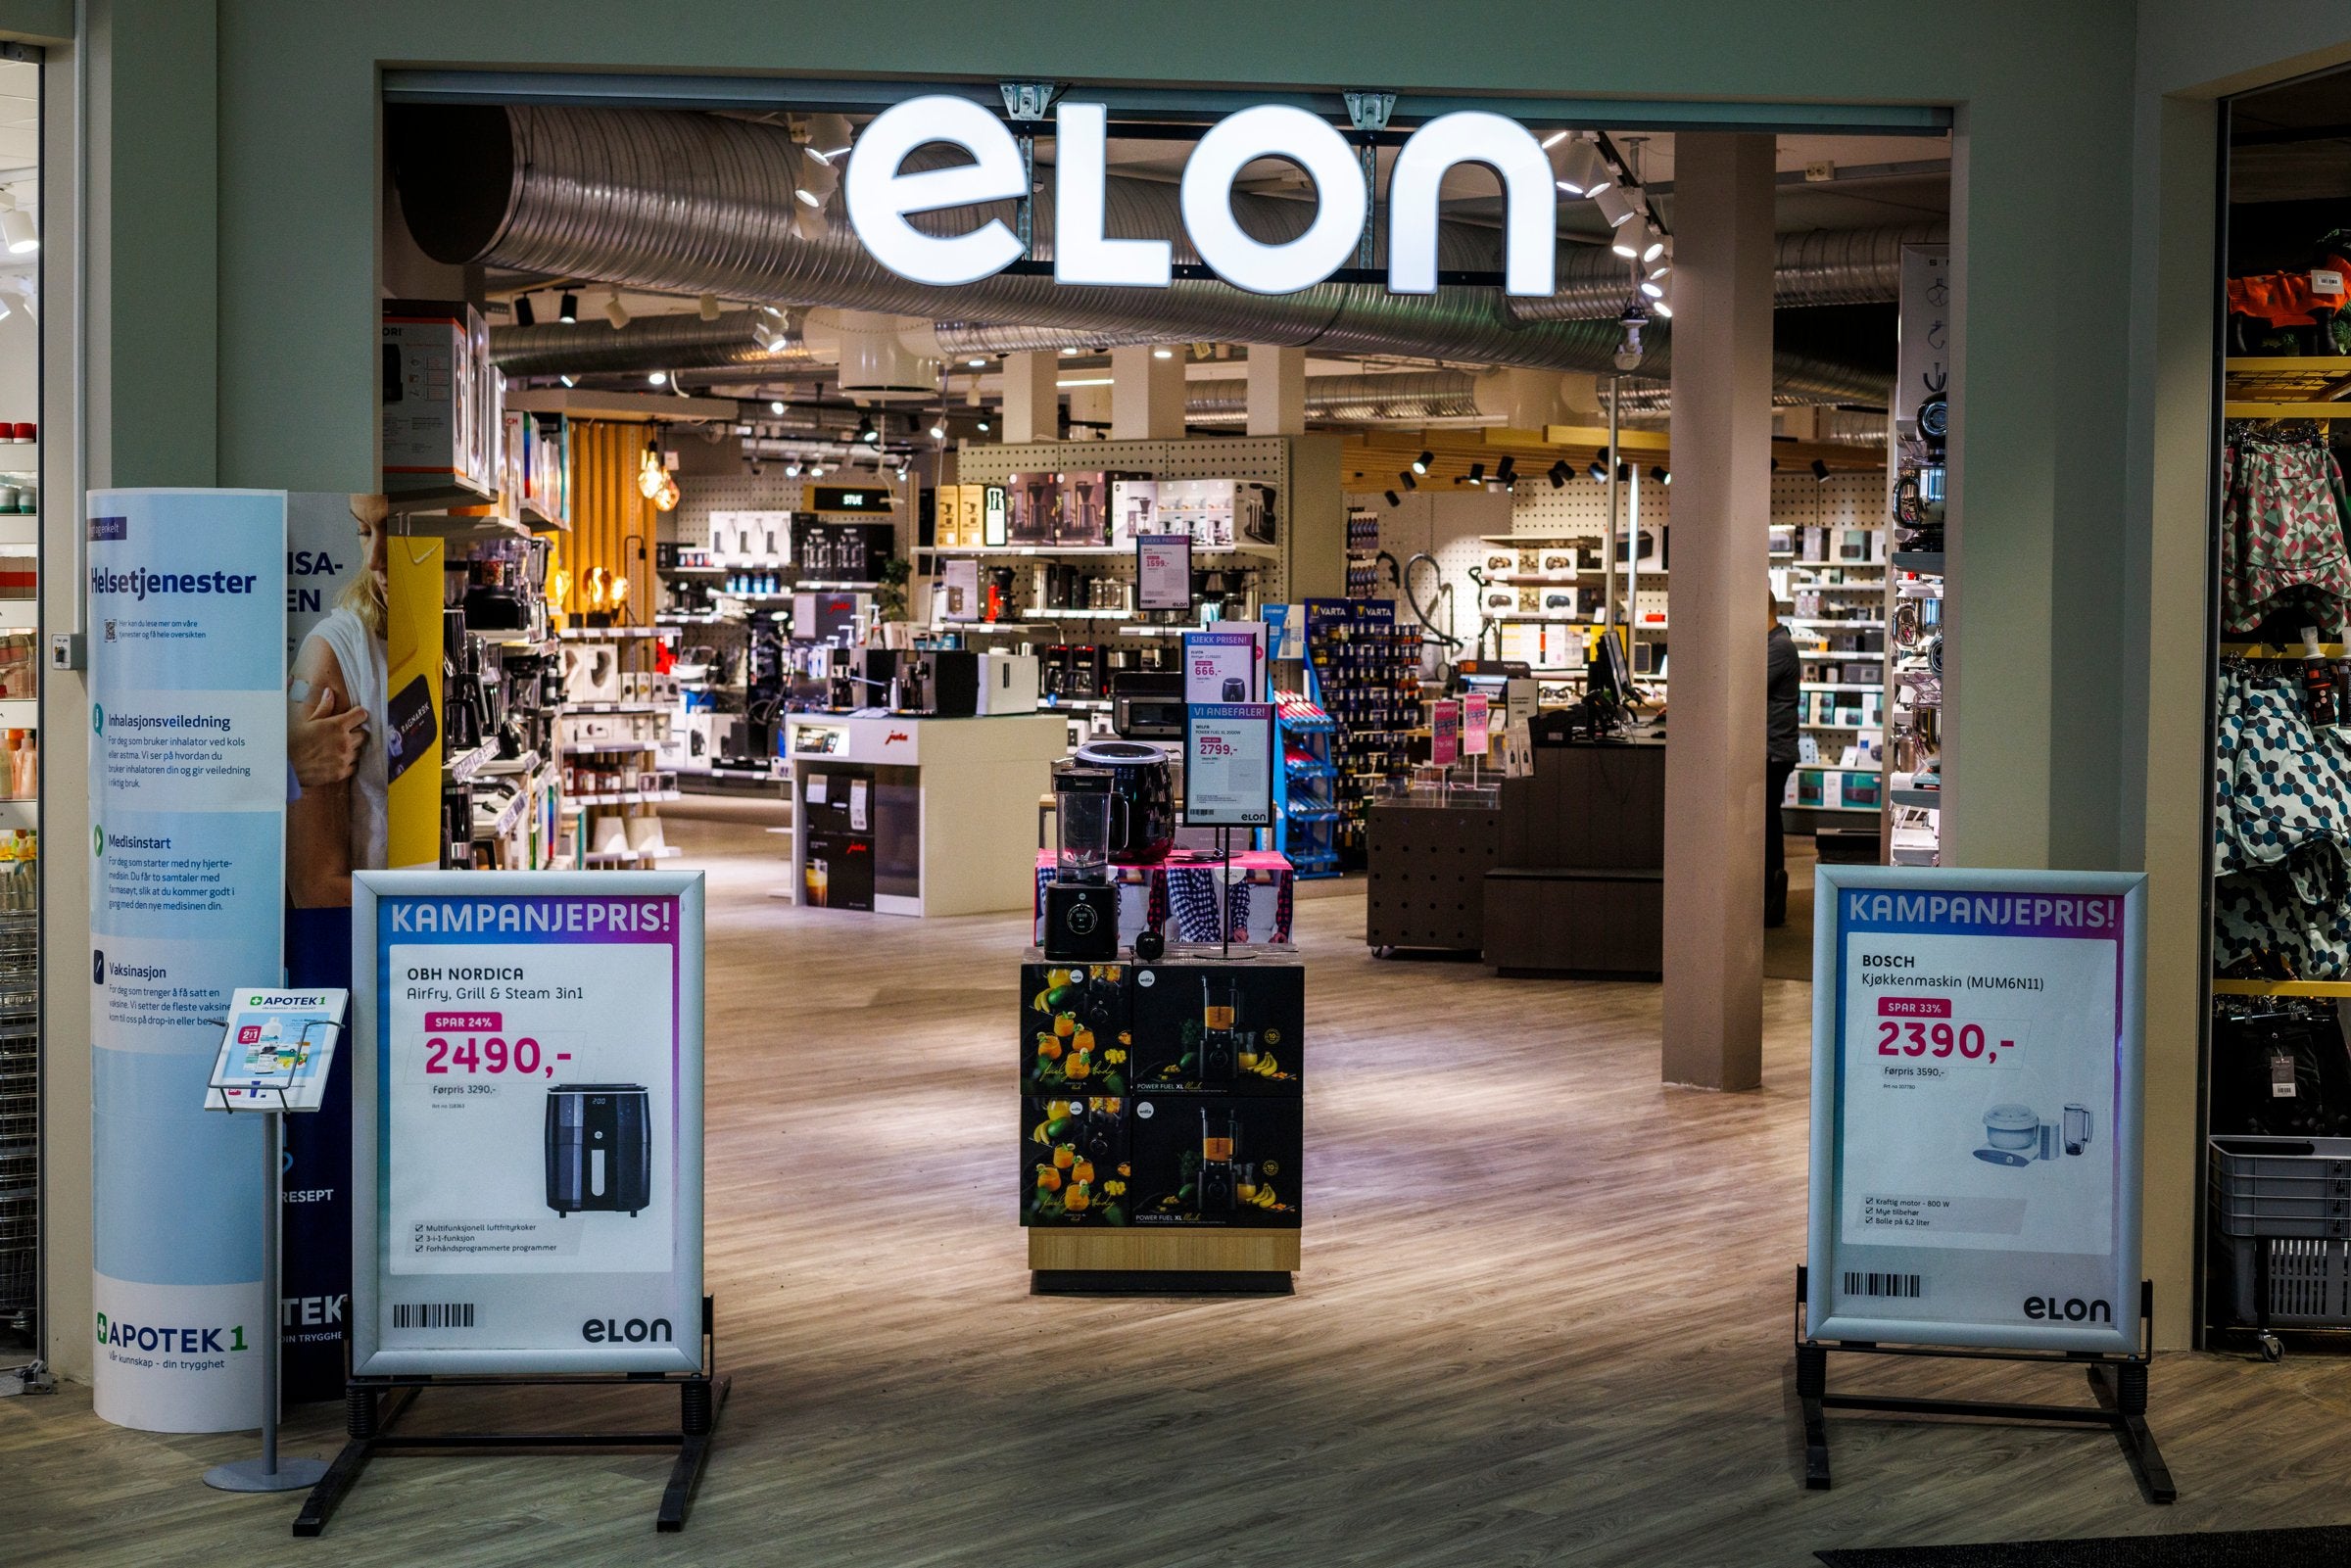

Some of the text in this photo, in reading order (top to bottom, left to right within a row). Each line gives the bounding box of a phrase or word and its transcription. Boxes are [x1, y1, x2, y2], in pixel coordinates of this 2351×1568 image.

[91, 567, 257, 601] Helsetjenester
[1320, 608, 1346, 617] VARTA
[1366, 608, 1391, 617] VARTA
[1195, 707, 1266, 716] VI ANBEFALER!
[108, 714, 231, 732] Inhalasjonsveiledning
[144, 737, 168, 746] bruker
[170, 737, 207, 746] inhalator
[209, 738, 226, 746] ved
[227, 738, 245, 746] kols
[1200, 744, 1238, 756] 2799,-
[141, 751, 149, 760] Vi
[163, 751, 173, 763] på
[175, 752, 209, 760] hvordan
[212, 752, 222, 760] du
[125, 765, 250, 777] inhalatoren din og gir veiledning
[108, 834, 171, 850] Medisinstart
[144, 859, 169, 868] starter
[171, 859, 190, 868] med
[191, 861, 201, 870] ny
[202, 859, 233, 870] hjerte-
[131, 872, 140, 881] Du
[162, 873, 199, 882] samtaler
[200, 873, 220, 882] med
[139, 886, 151, 895] slik
[161, 887, 171, 896] du
[172, 887, 208, 896] kommer
[209, 887, 230, 898] godt
[148, 902, 223, 912] nye medisinen din.
[1849, 893, 2116, 928] KAMPANJEPRIS!
[392, 902, 671, 932] KAMPANJEPRIS!
[1862, 954, 1915, 969] BOSCH
[109, 962, 167, 981] Vaksinasjon
[408, 968, 524, 980] OBH NORDICA
[1862, 973, 2044, 991] Kjøkkenmaskin (MUM6N11)
[128, 988, 142, 996] som
[144, 988, 172, 999] trenger
[179, 987, 189, 997] få
[190, 989, 208, 997] satt
[456, 987, 486, 1000] Grill
[490, 987, 501, 1000] &
[505, 987, 550, 1000] Steam
[556, 986, 584, 1000] 3in1
[130, 1000, 137, 1010] Vi
[138, 1002, 159, 1011] setter
[161, 1001, 171, 1011] de
[172, 1001, 197, 1011] fleste
[264, 997, 326, 1006] APOTEK 1
[1888, 1002, 1942, 1014] SPAR 33%
[138, 1015, 147, 1026] på
[148, 1016, 175, 1027] drop-in
[176, 1016, 195, 1025] eller
[435, 1017, 492, 1028] SPAR 24%
[1878, 1021, 2015, 1064] 2390,-
[426, 1037, 572, 1079] 2490,-
[1884, 1067, 1945, 1078] Førpris 3590,-
[433, 1085, 497, 1097] Førpris 3290,-
[282, 1188, 334, 1203] RESEPT
[1876, 1198, 1898, 1208] Kraftig
[1927, 1199, 1941, 1208] 800
[1876, 1207, 1919, 1217] Mye tilbehør
[426, 1223, 536, 1233] Multifunksjonell luftfrityrkoker
[1876, 1217, 1892, 1226] Bolle
[1894, 1217, 1903, 1228] på
[1916, 1217, 1930, 1226] liter
[426, 1234, 475, 1243] 3-i-1-funksjon
[426, 1244, 557, 1254] Forhåndsprogrammerte programmer
[109, 1321, 248, 1354] APOTEK 1
[109, 1352, 225, 1371] Vår kunnskap din trygghet
